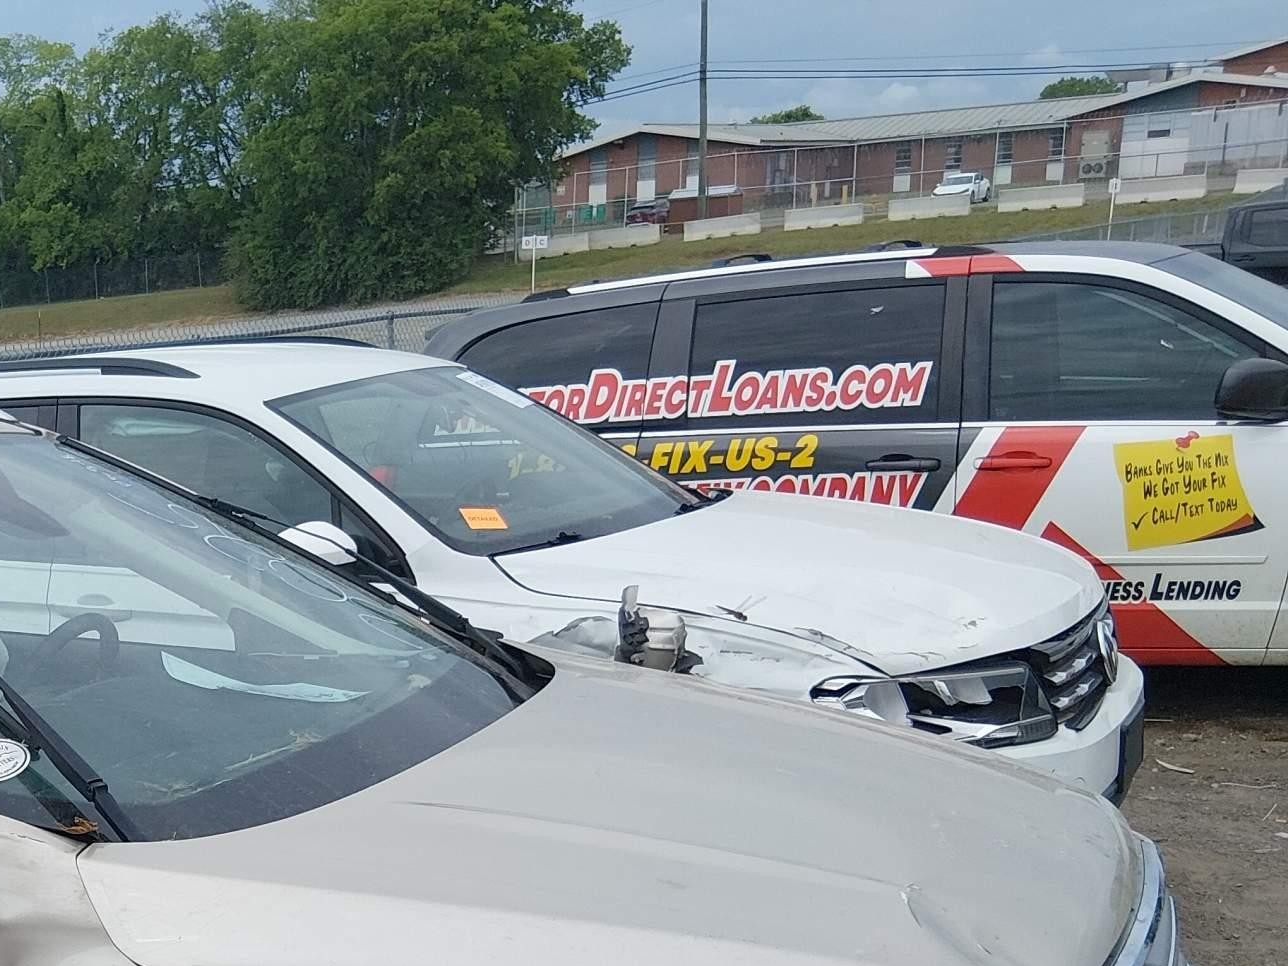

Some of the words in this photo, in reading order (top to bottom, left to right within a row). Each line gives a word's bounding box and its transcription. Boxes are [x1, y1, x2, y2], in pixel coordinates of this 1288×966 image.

[1156, 459, 1174, 475] GIVE
[1177, 457, 1193, 473] YOU
[1196, 454, 1212, 469] THE
[1143, 480, 1158, 500] WE
[1162, 478, 1179, 497] GOT
[1183, 475, 1207, 494] YOUR
[1211, 472, 1226, 490] FIX
[1152, 503, 1204, 524] CALL/TEXT
[1208, 498, 1238, 512] TODAY
[1149, 573, 1242, 601] LENDING
